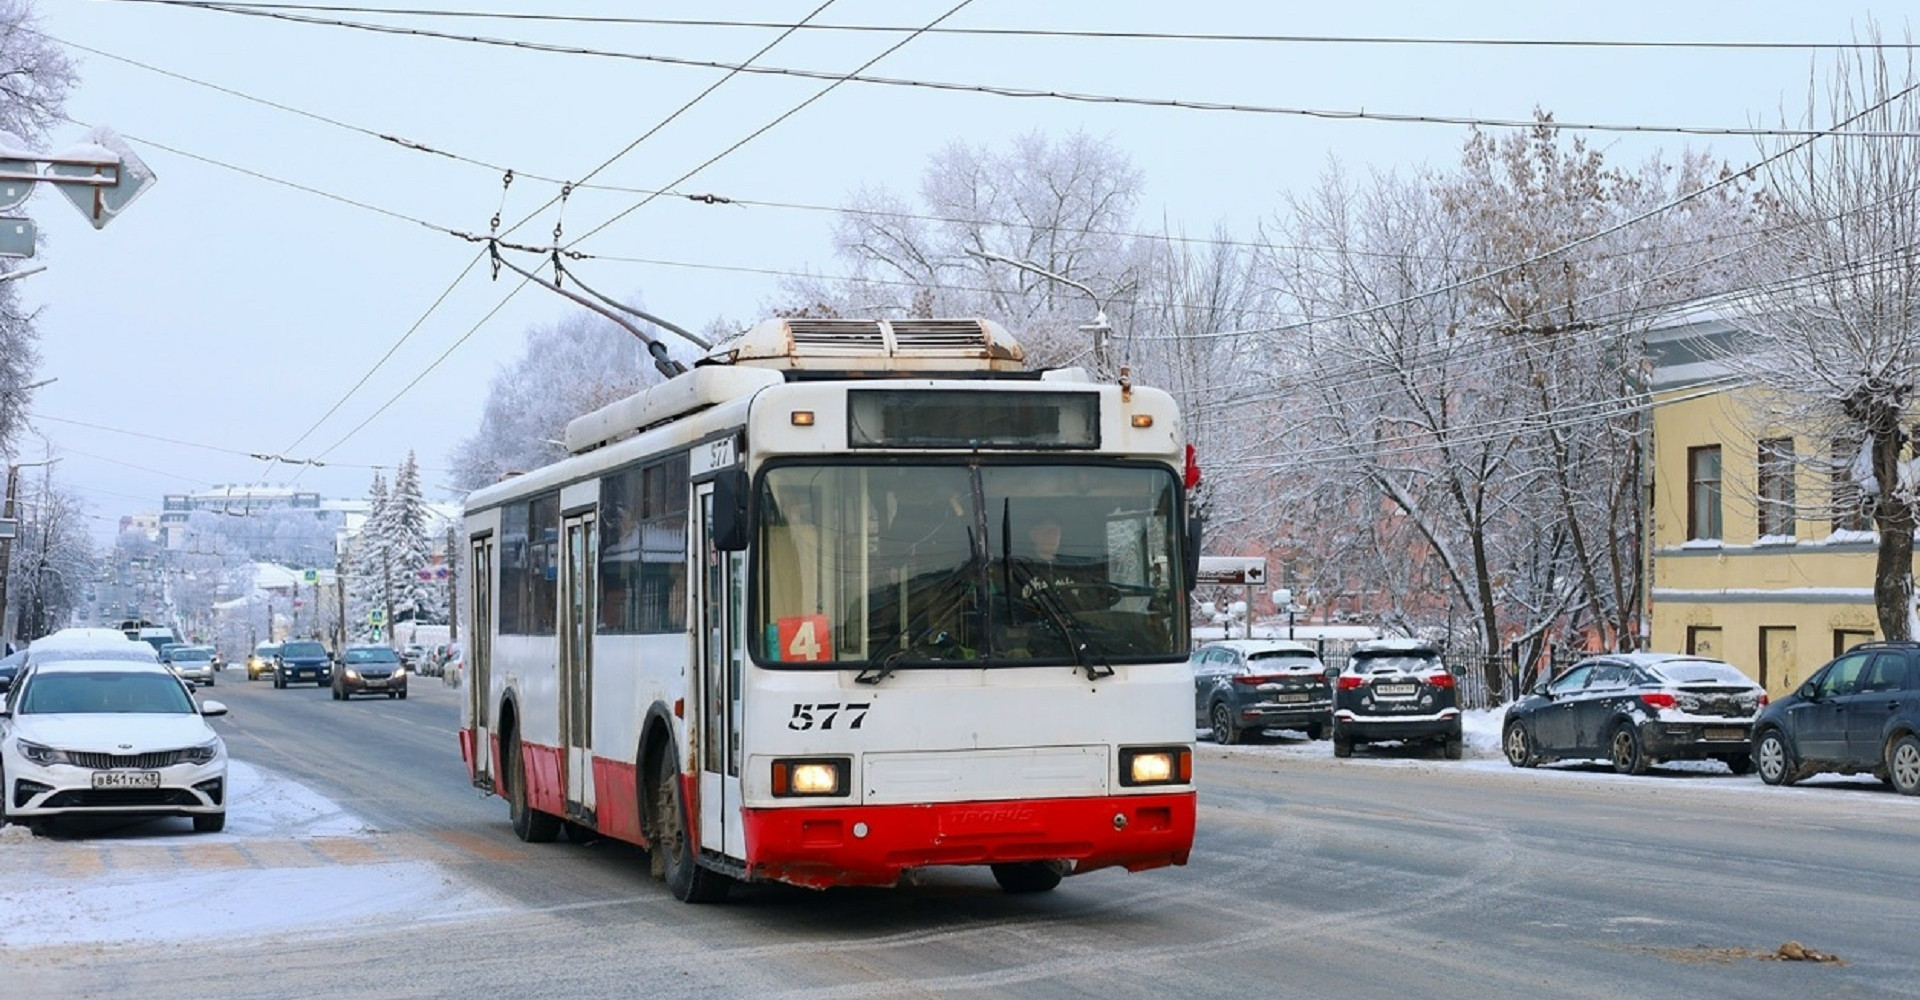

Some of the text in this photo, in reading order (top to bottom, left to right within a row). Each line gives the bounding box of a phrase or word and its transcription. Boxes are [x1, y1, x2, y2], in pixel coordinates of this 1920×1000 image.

[710, 440, 728, 468] 577
[789, 621, 821, 660] 4
[787, 702, 871, 731] 577
